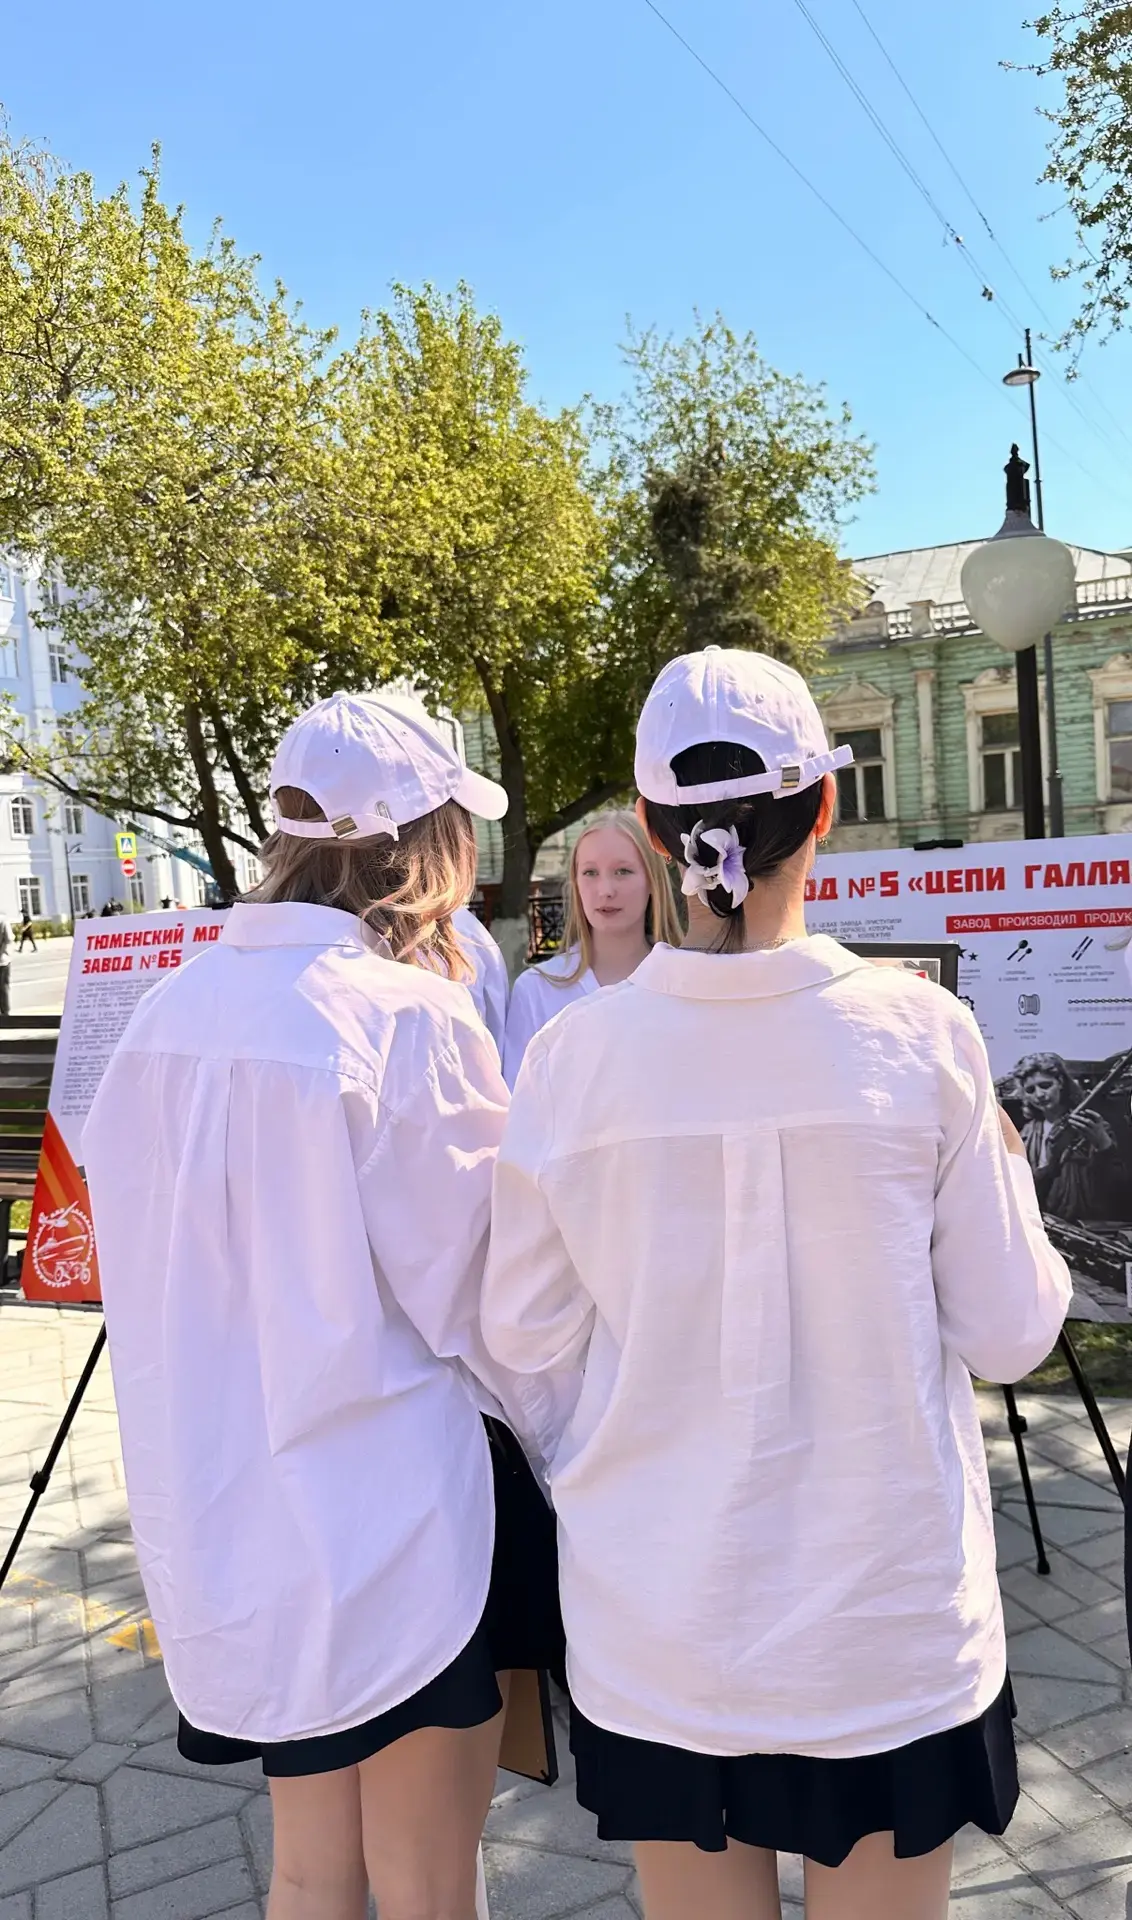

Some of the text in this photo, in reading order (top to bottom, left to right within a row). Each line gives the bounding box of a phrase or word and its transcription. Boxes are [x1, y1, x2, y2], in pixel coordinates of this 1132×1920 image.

[908, 867, 1005, 894] «ЦЕПИ
[1025, 860, 1131, 889] ГАЛЛЯ
[953, 911, 1132, 930] ЗАВОД ПРОИЗВОДИЛ ПРОДУК
[87, 923, 224, 951] ТЮМЕНСКИЙ МО
[82, 955, 133, 974] ЗАВОД
